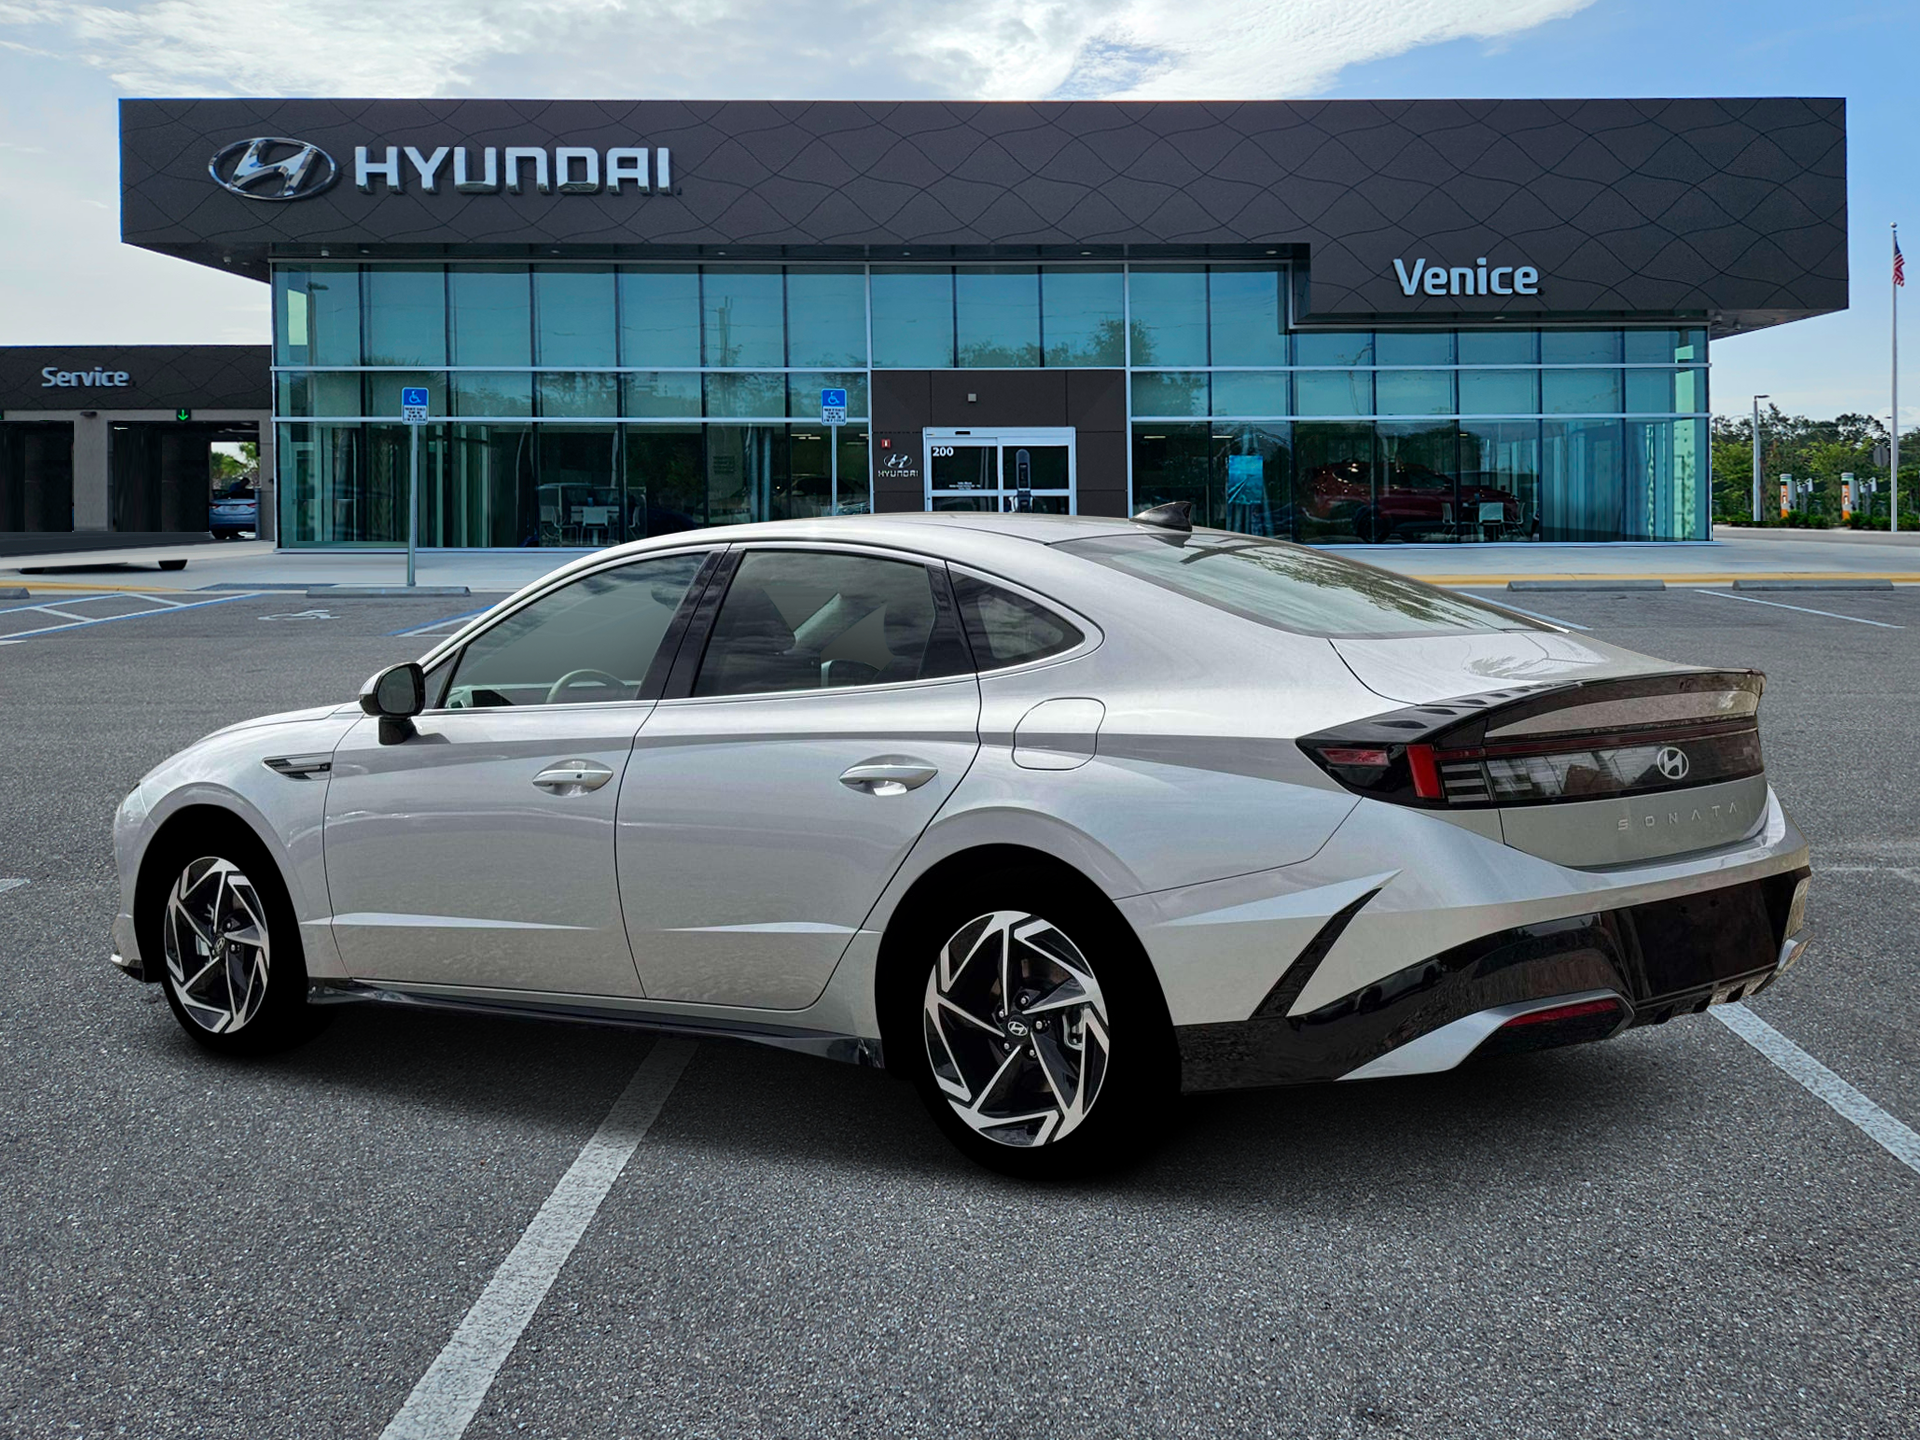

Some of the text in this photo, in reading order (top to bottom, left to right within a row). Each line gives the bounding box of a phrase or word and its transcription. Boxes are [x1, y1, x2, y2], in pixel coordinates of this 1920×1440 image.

[354, 146, 670, 193] HYUNDAI
[1393, 257, 1539, 295] Venice
[41, 366, 130, 387] Service
[932, 447, 954, 457] 200
[878, 469, 919, 478] HYUNDAI
[1617, 801, 1738, 831] SONATA
